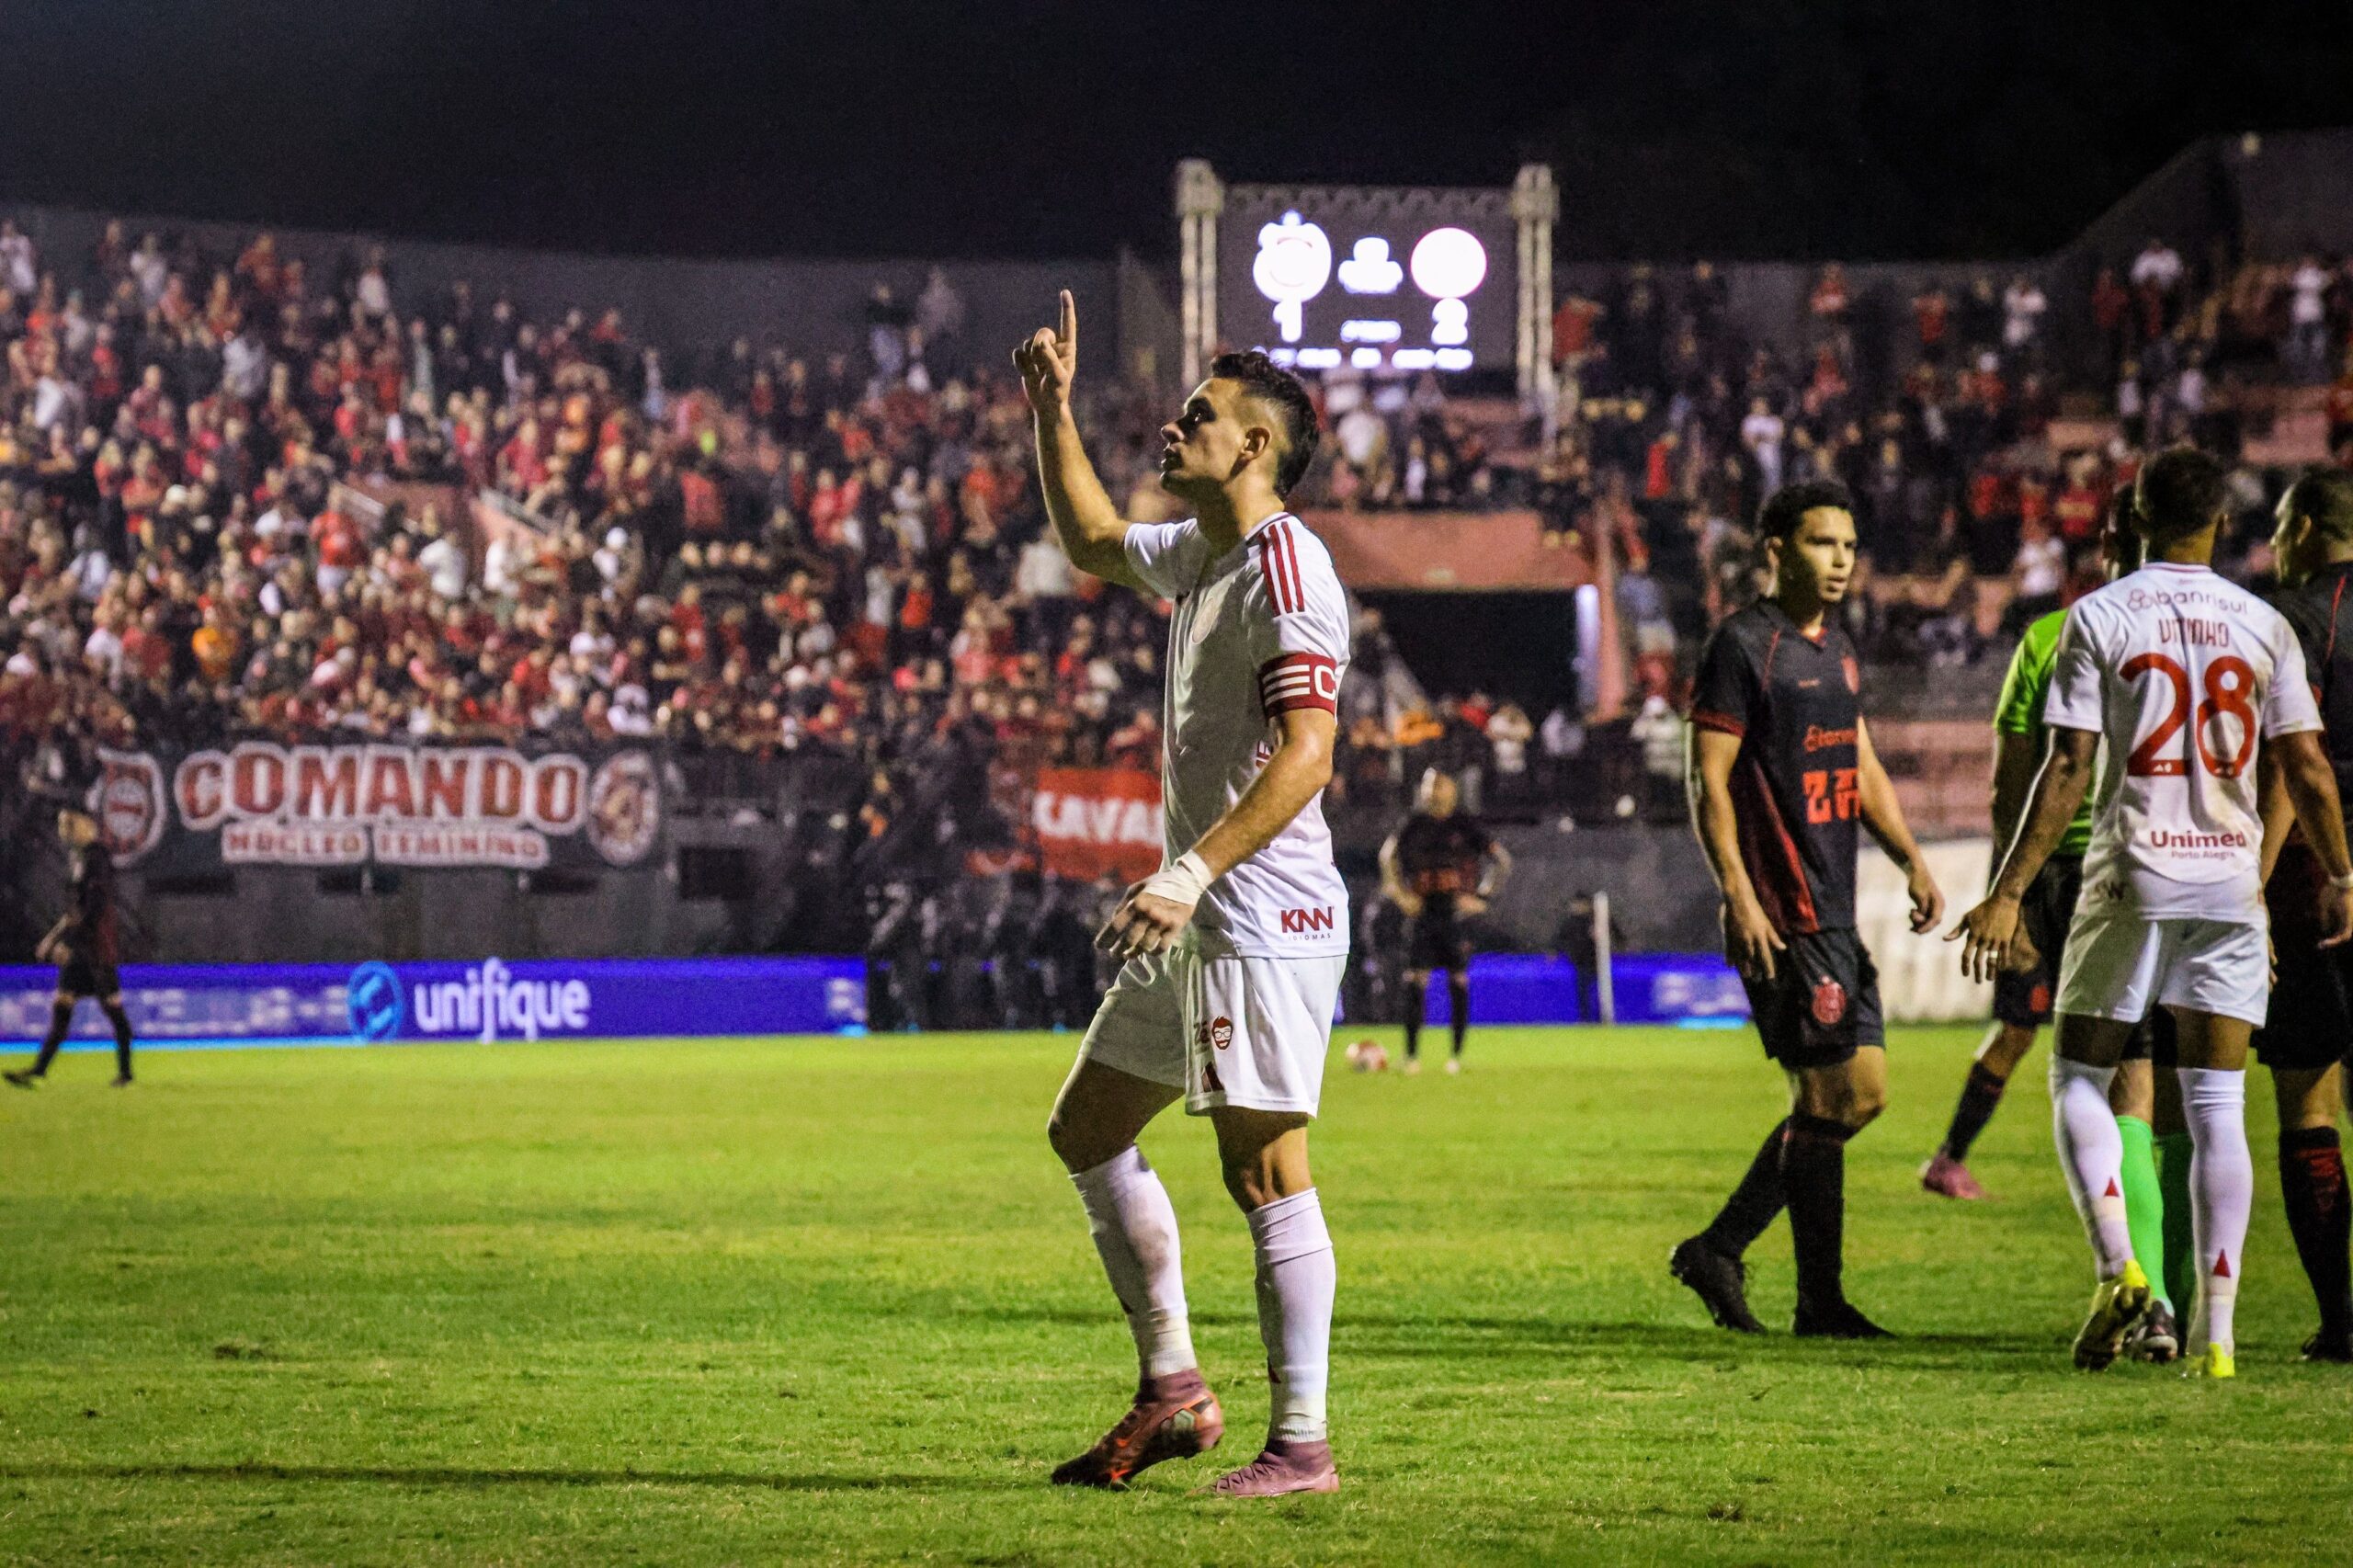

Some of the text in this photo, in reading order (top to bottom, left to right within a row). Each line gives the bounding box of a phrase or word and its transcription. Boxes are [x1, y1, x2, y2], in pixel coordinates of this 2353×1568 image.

[2155, 590, 2247, 614] banrisul
[1313, 664, 1336, 701] C
[2119, 652, 2256, 779] 28
[178, 749, 583, 825] COMANDO
[2151, 830, 2247, 848] Unimed
[1280, 906, 1334, 934] KNN
[1288, 933, 1331, 942] IDIOMAS
[414, 956, 592, 1045] unifique
